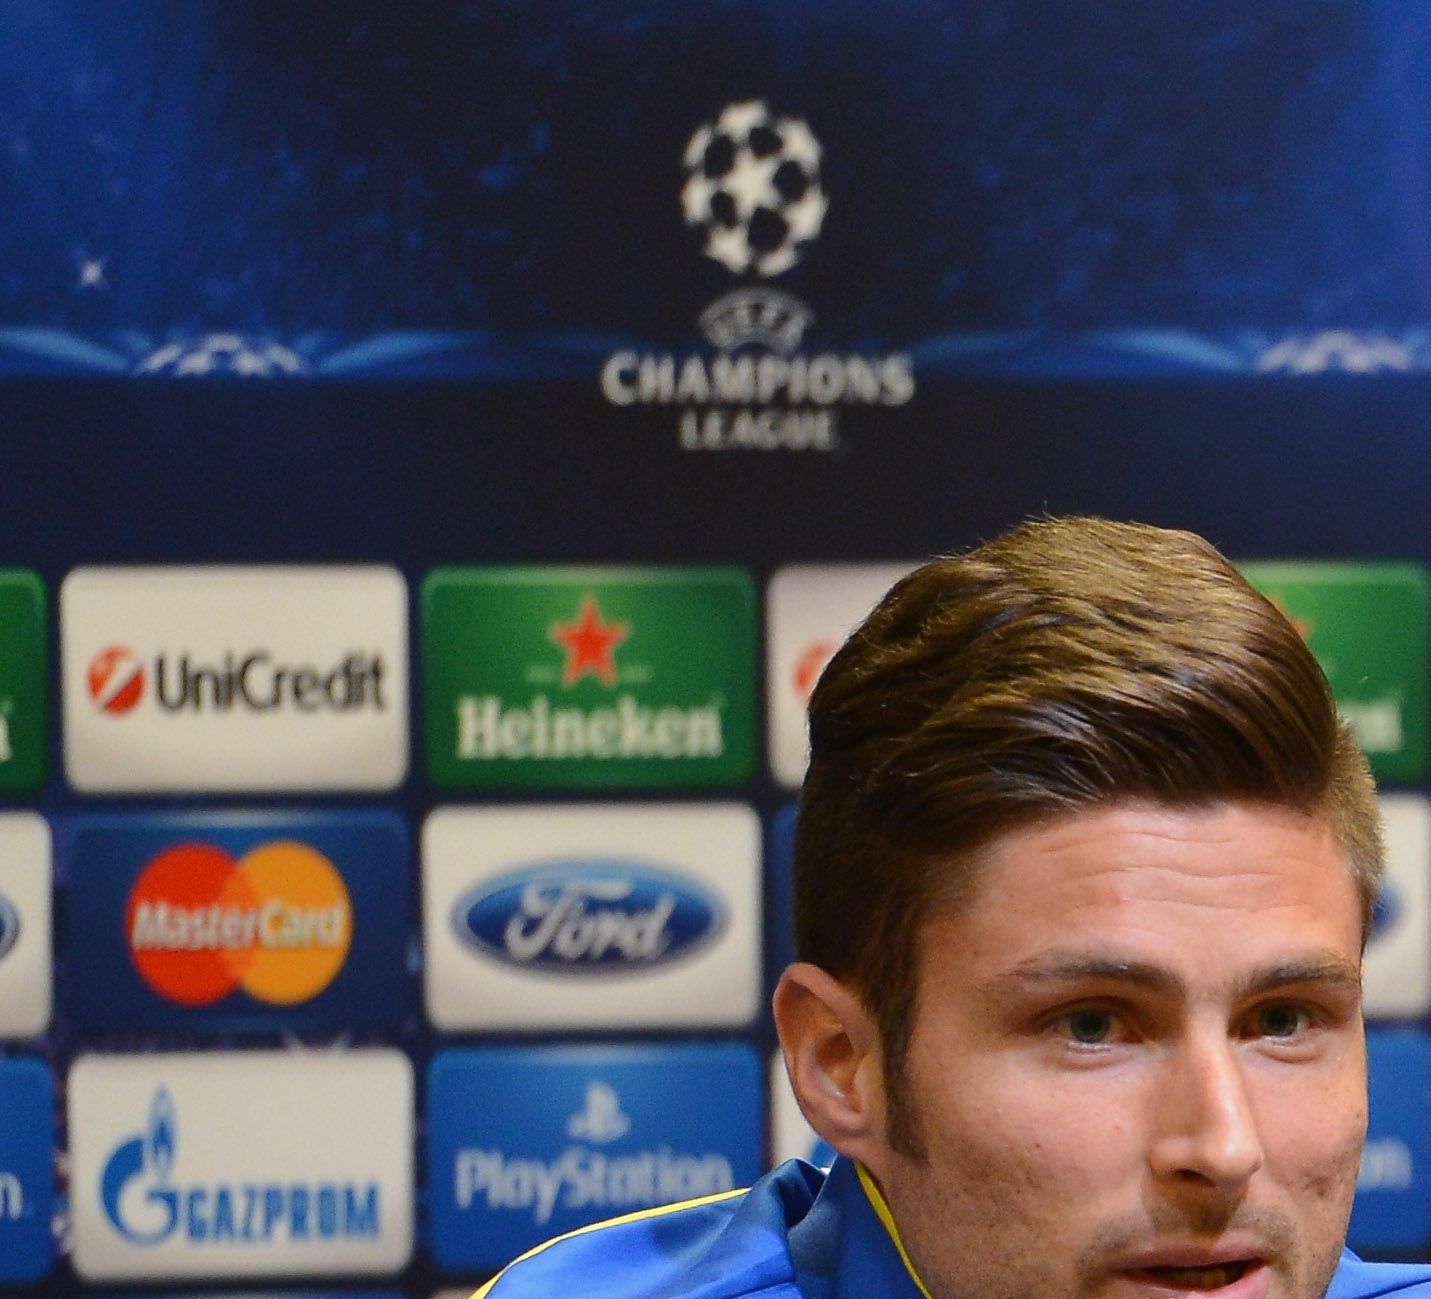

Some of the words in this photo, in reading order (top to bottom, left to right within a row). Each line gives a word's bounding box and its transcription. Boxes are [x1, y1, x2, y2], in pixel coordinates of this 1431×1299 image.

[601, 350, 916, 406] CHAMPIONS
[153, 650, 387, 713] UniCredit
[457, 694, 724, 760] Heineken
[132, 900, 346, 951] MasterCard
[503, 879, 674, 960] Ford
[456, 1144, 733, 1224] PlayStation
